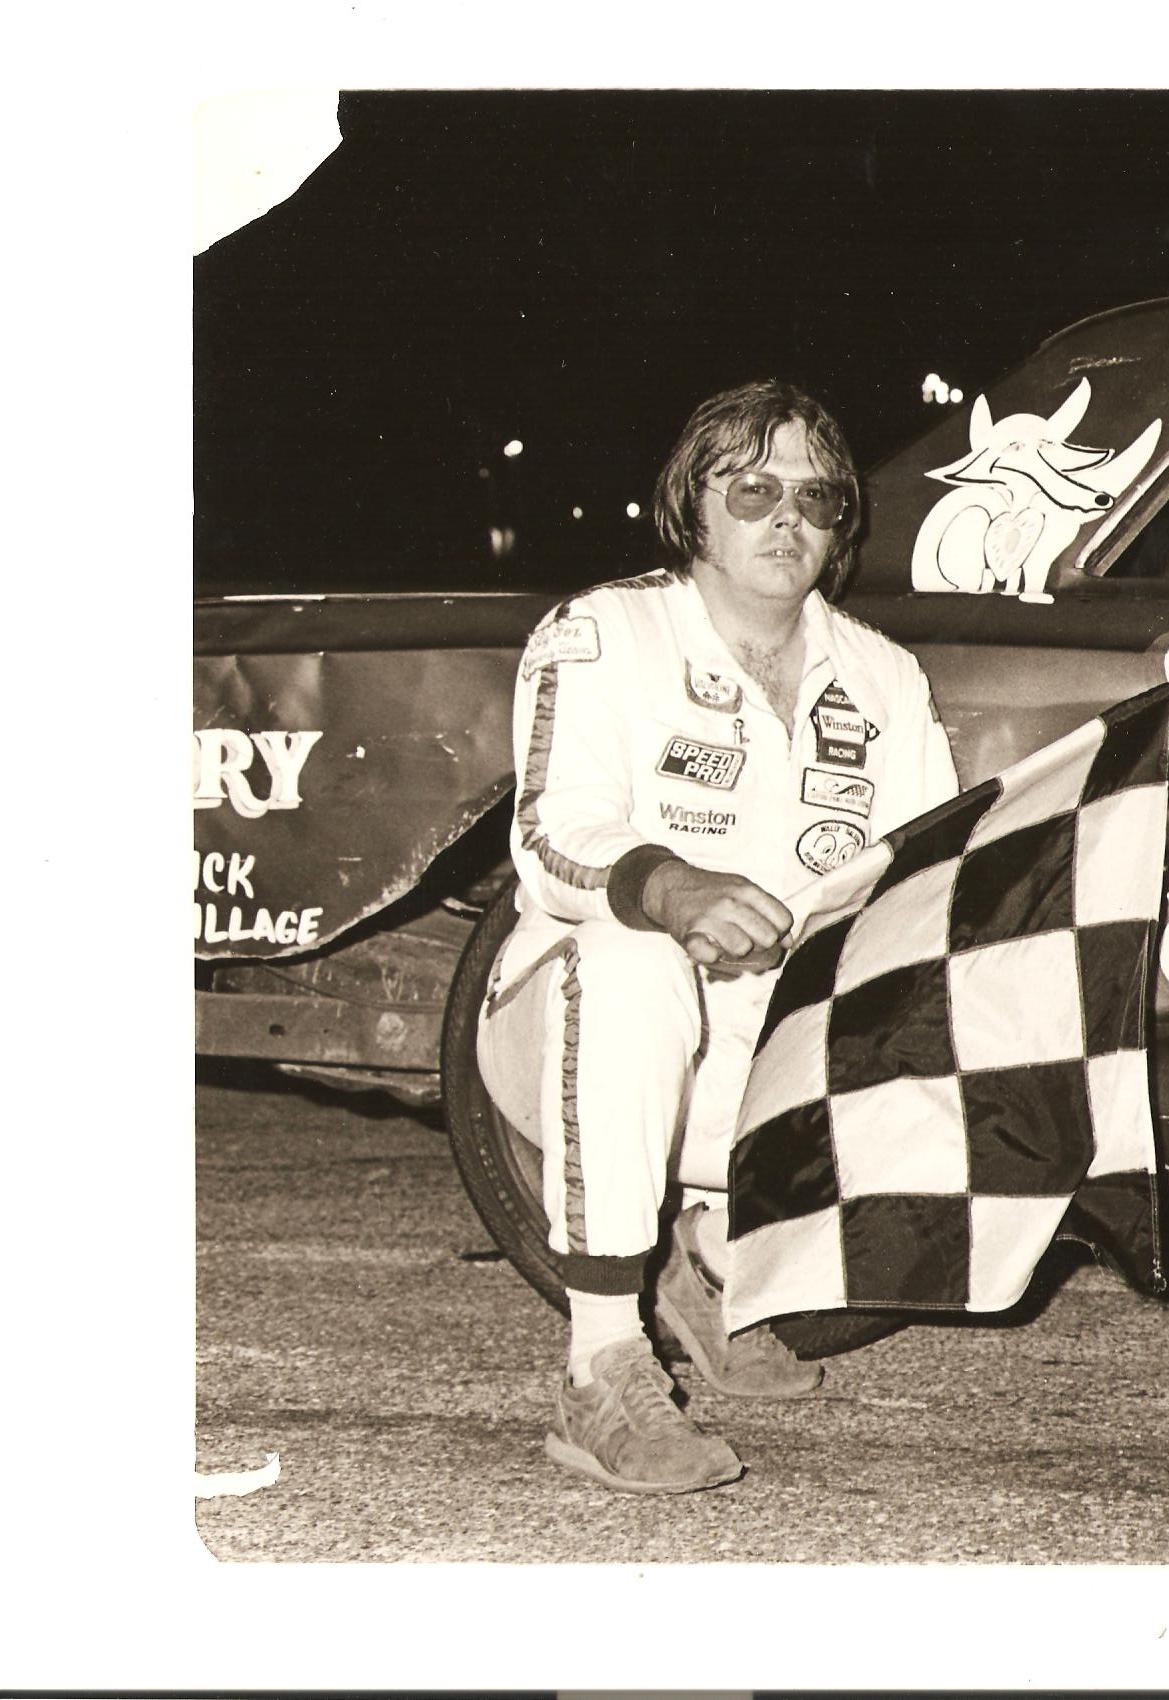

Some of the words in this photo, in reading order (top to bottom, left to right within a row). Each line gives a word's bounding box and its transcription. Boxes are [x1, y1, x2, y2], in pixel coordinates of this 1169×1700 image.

[824, 692, 852, 705] NASCA
[822, 714, 864, 734] Winston
[669, 741, 735, 770] SPEED
[828, 746, 857, 760] RACING
[683, 760, 727, 785] PRO
[659, 801, 737, 826] Winston
[668, 823, 728, 835] RACING
